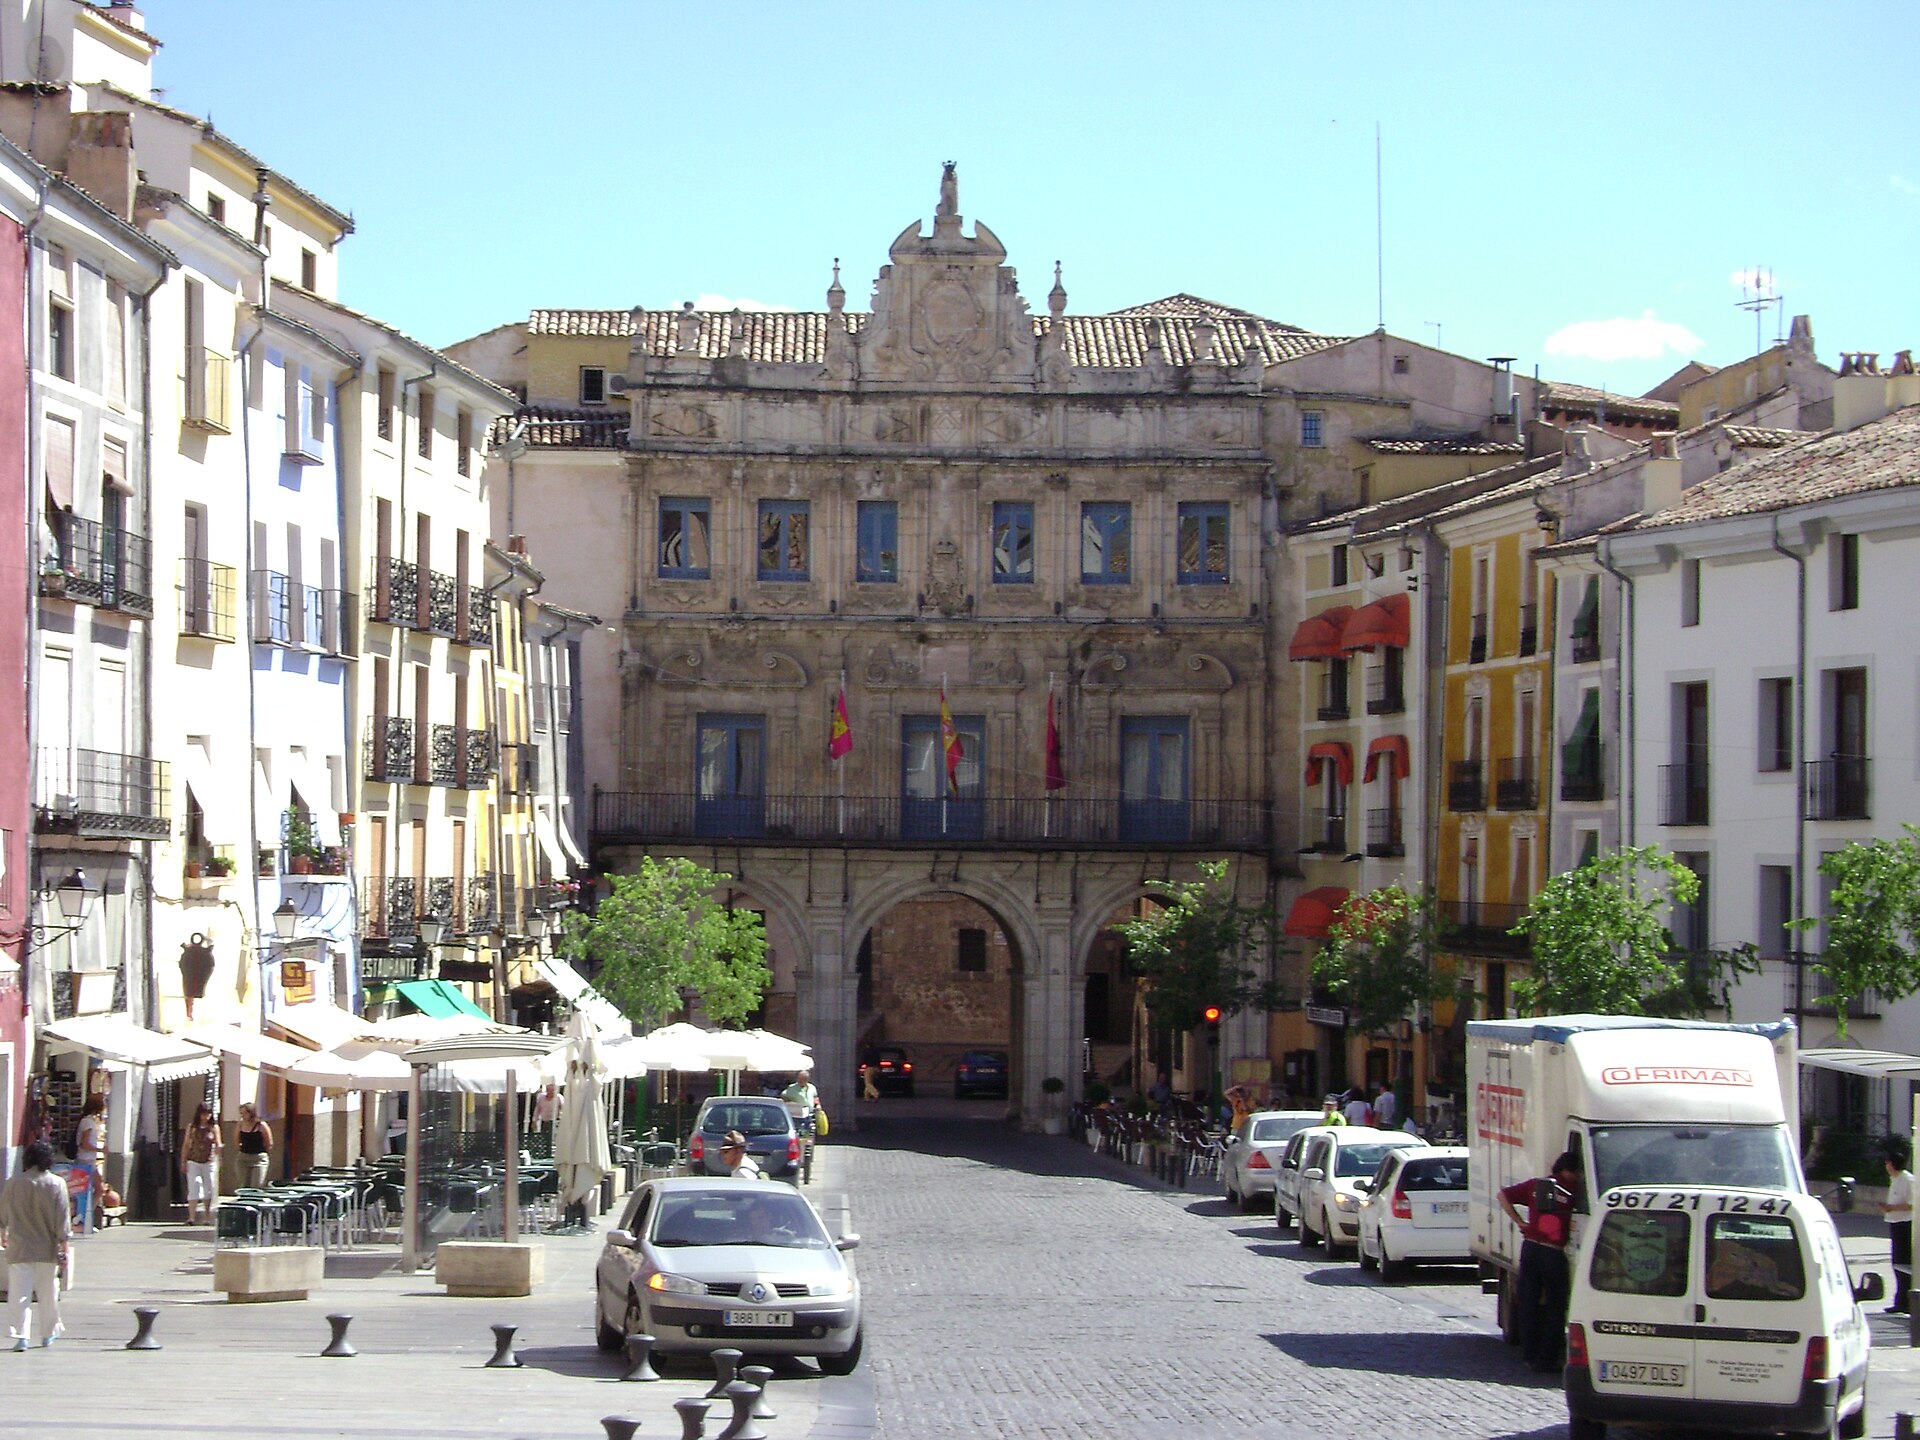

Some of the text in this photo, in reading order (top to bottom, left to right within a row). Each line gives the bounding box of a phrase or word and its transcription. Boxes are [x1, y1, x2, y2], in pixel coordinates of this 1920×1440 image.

[361, 957, 418, 978] ESTAURANTE
[1601, 1066, 1754, 1088] COFRIMAN
[1606, 1191, 1793, 1216] 967 21 12 47
[733, 1312, 759, 1324] 3881
[1611, 1364, 1680, 1381] 0497 DLS
